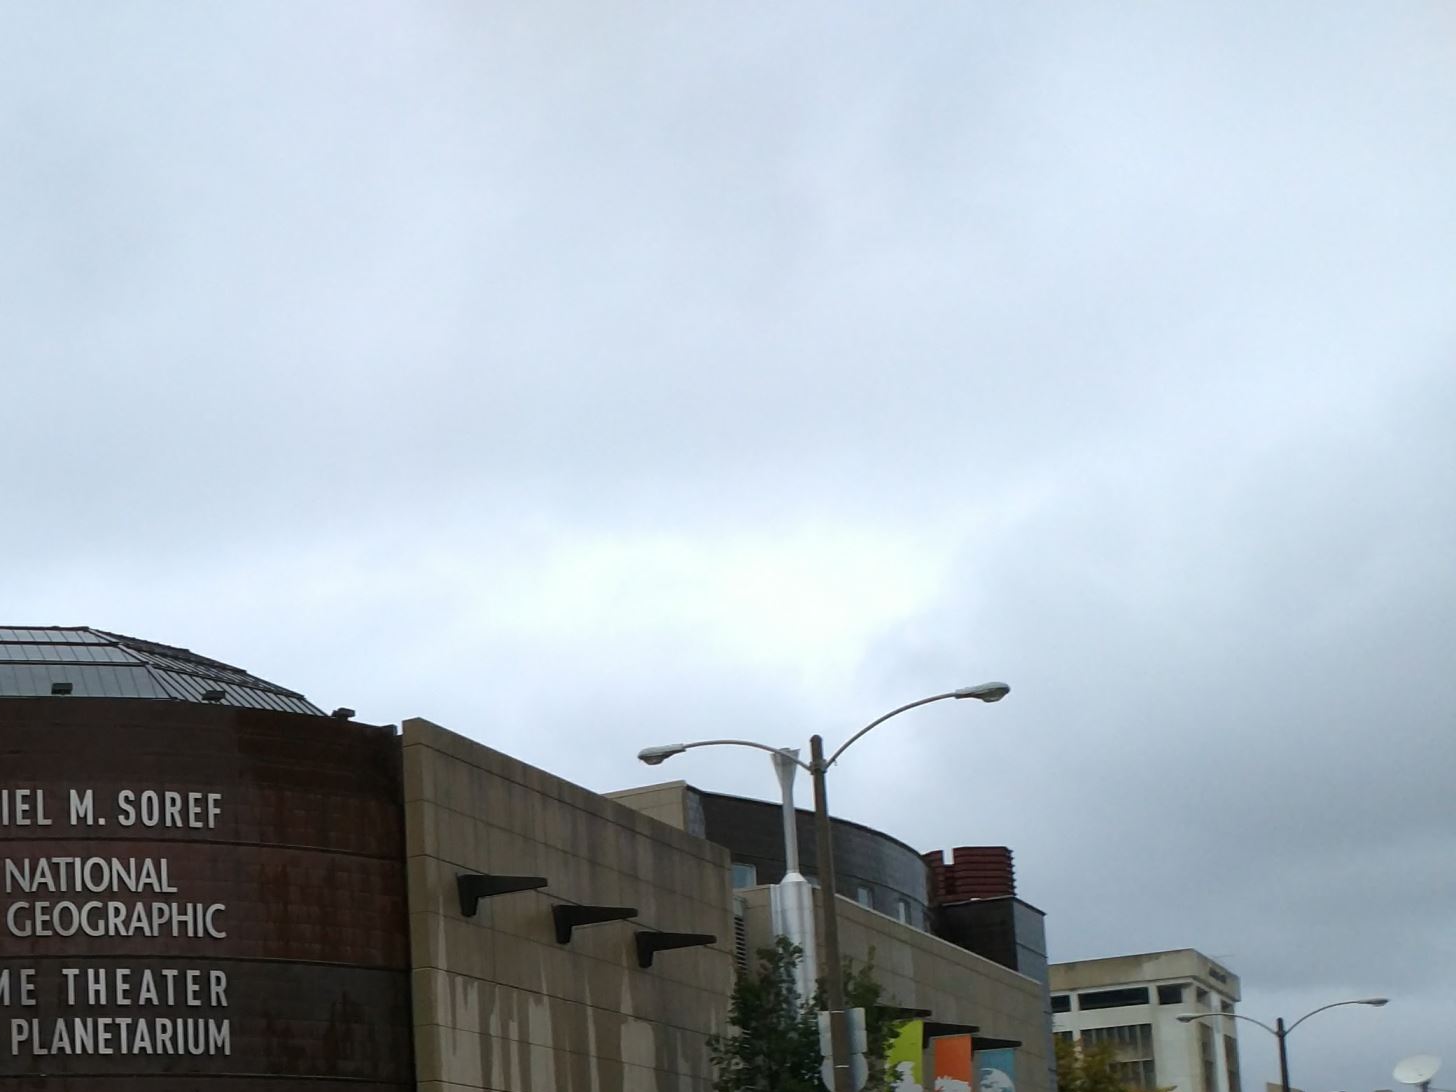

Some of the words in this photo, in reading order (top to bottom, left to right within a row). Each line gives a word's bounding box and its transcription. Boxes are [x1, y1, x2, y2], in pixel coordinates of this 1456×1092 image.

[69, 789, 107, 826] M.
[117, 789, 222, 829] SOREF
[4, 856, 179, 893] NATIONAL
[6, 900, 228, 939] GEOGRAPHIC
[62, 968, 229, 1007] THEATER
[10, 1017, 232, 1056] PLANETARIUM
